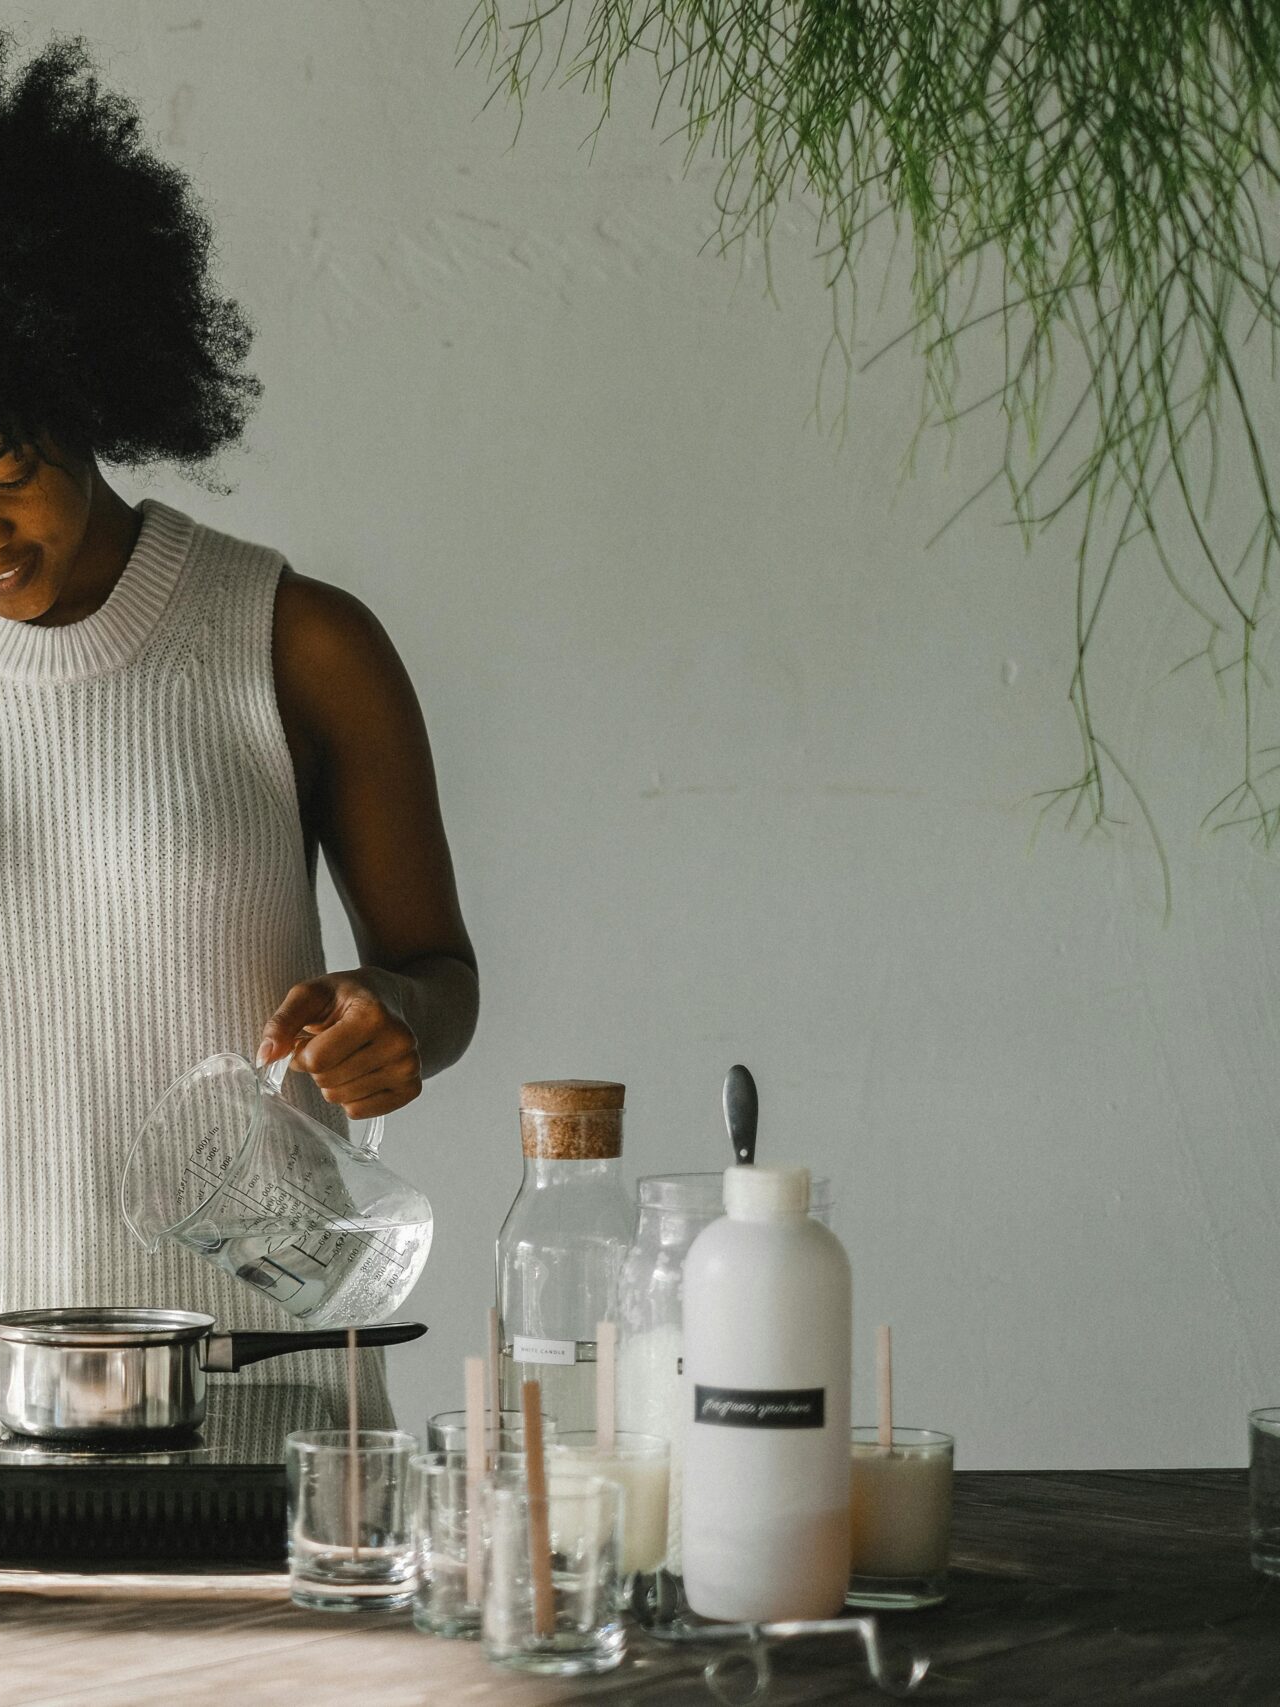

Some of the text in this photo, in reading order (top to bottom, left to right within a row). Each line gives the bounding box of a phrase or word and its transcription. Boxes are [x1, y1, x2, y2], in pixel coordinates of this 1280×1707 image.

[289, 1212, 302, 1227] 800
[304, 1220, 317, 1236] 700
[361, 1257, 373, 1272] 300
[386, 1273, 399, 1289] 100
